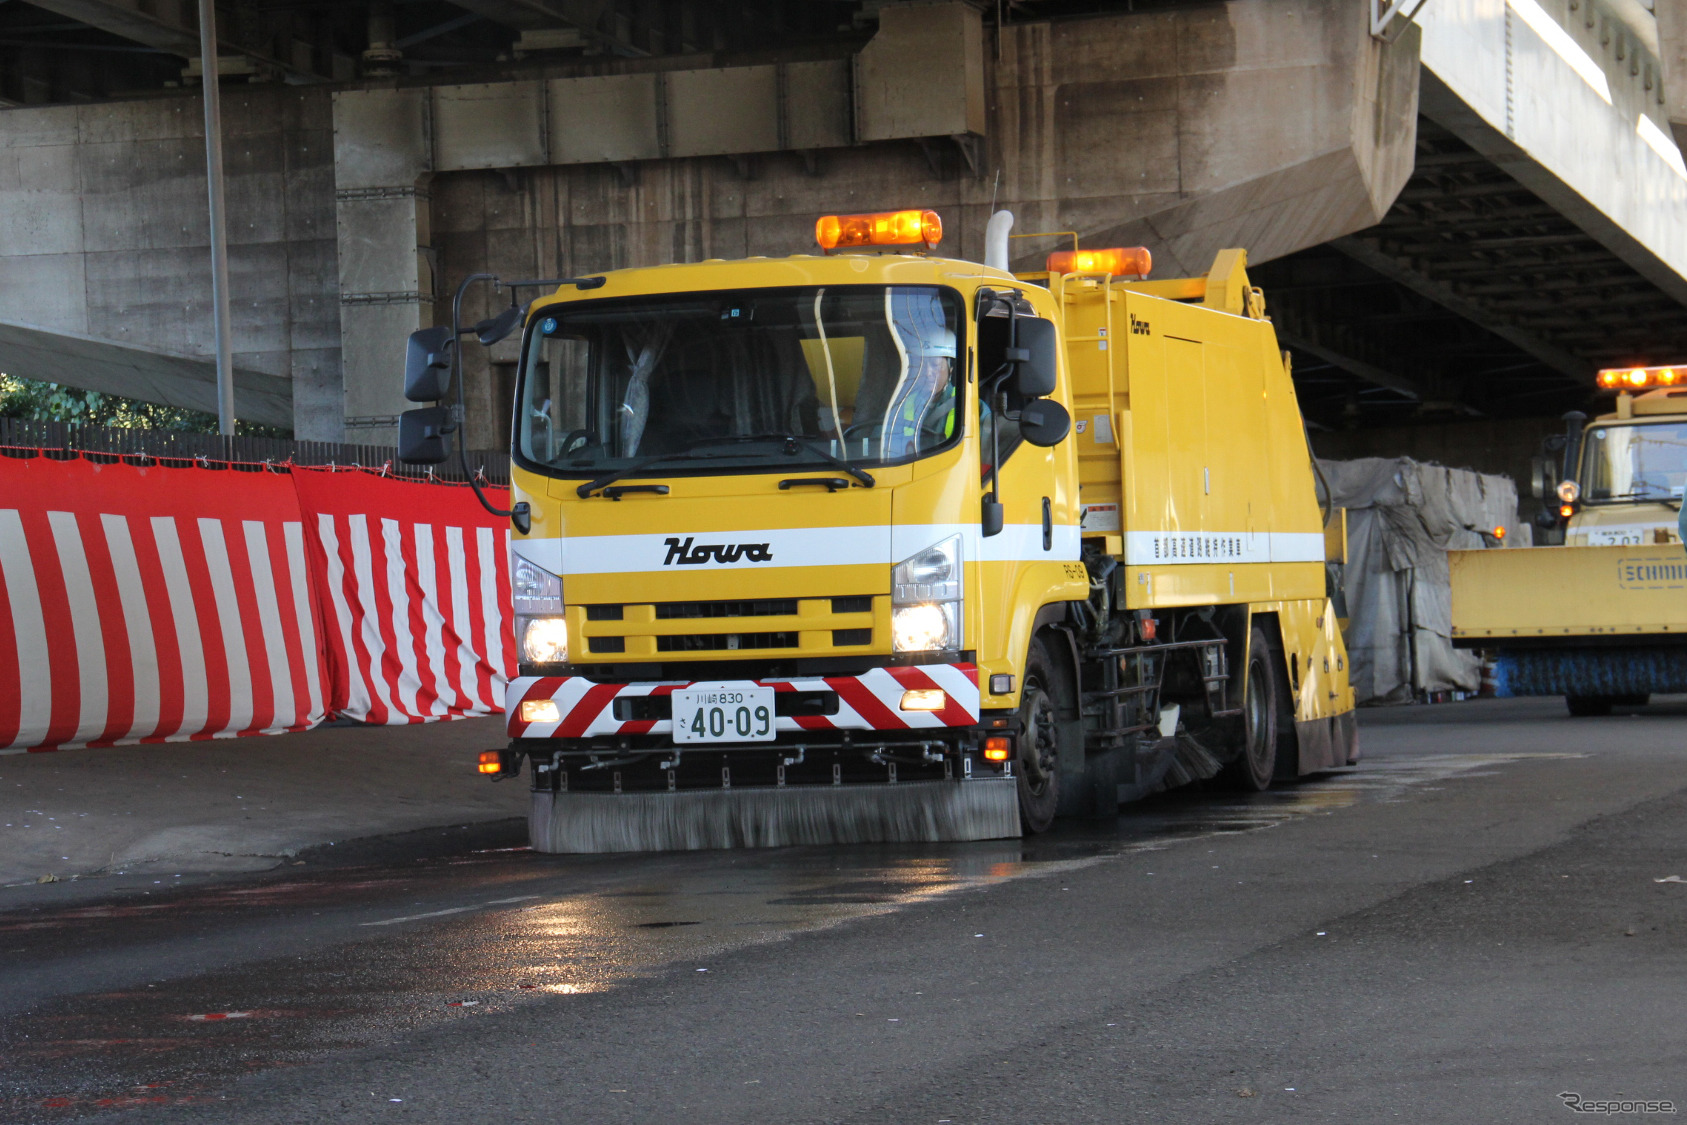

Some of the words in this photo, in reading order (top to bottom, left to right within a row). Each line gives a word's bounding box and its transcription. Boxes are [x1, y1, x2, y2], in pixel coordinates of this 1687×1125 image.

[663, 537, 773, 565] Howa
[719, 693, 743, 704] 830
[691, 706, 770, 738] 40-09
